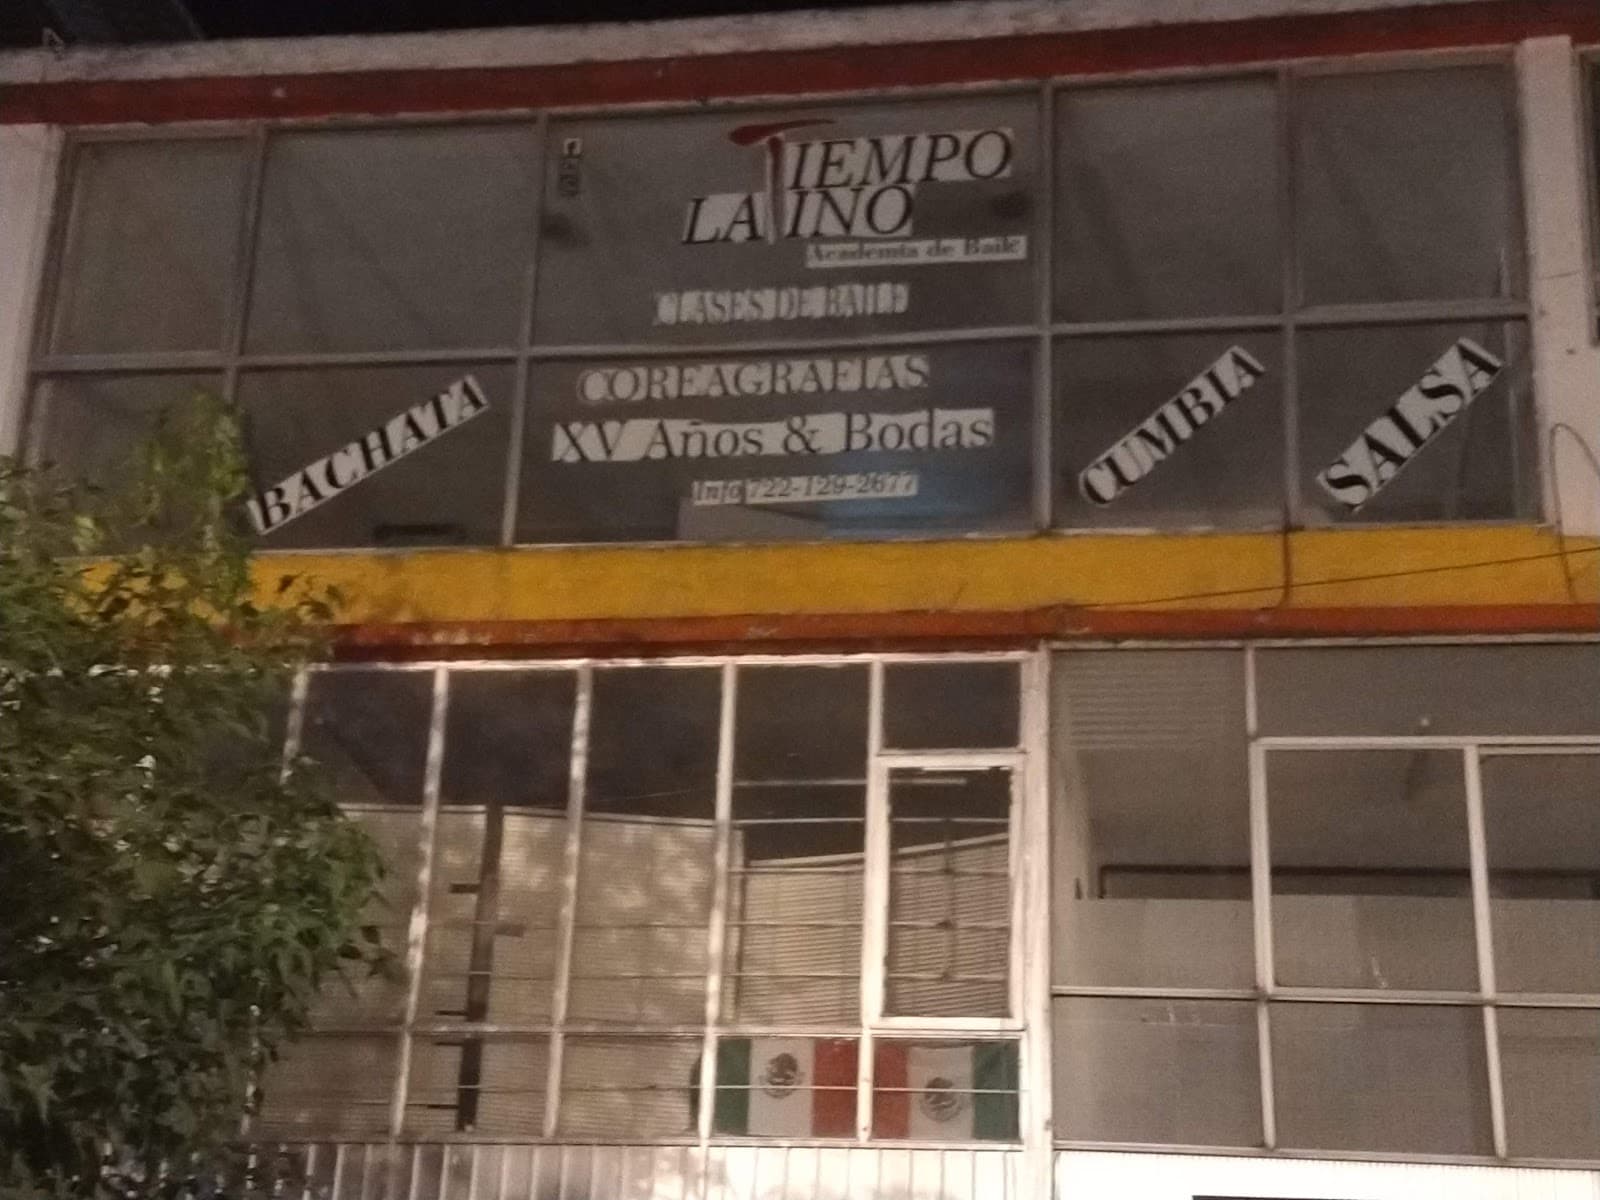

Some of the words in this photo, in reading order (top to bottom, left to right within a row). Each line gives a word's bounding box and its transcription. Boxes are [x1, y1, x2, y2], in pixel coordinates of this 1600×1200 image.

[729, 119, 1013, 191] TIEMPO
[925, 240, 956, 259] de
[577, 353, 929, 402] COREAGRAFIAS
[247, 374, 488, 534] BACHATA
[553, 421, 629, 463] XV
[643, 418, 764, 459] Años
[783, 415, 822, 453] &
[844, 408, 994, 453] Bodas
[1079, 345, 1265, 505] CUMBIA
[1316, 337, 1504, 512] SALSA
